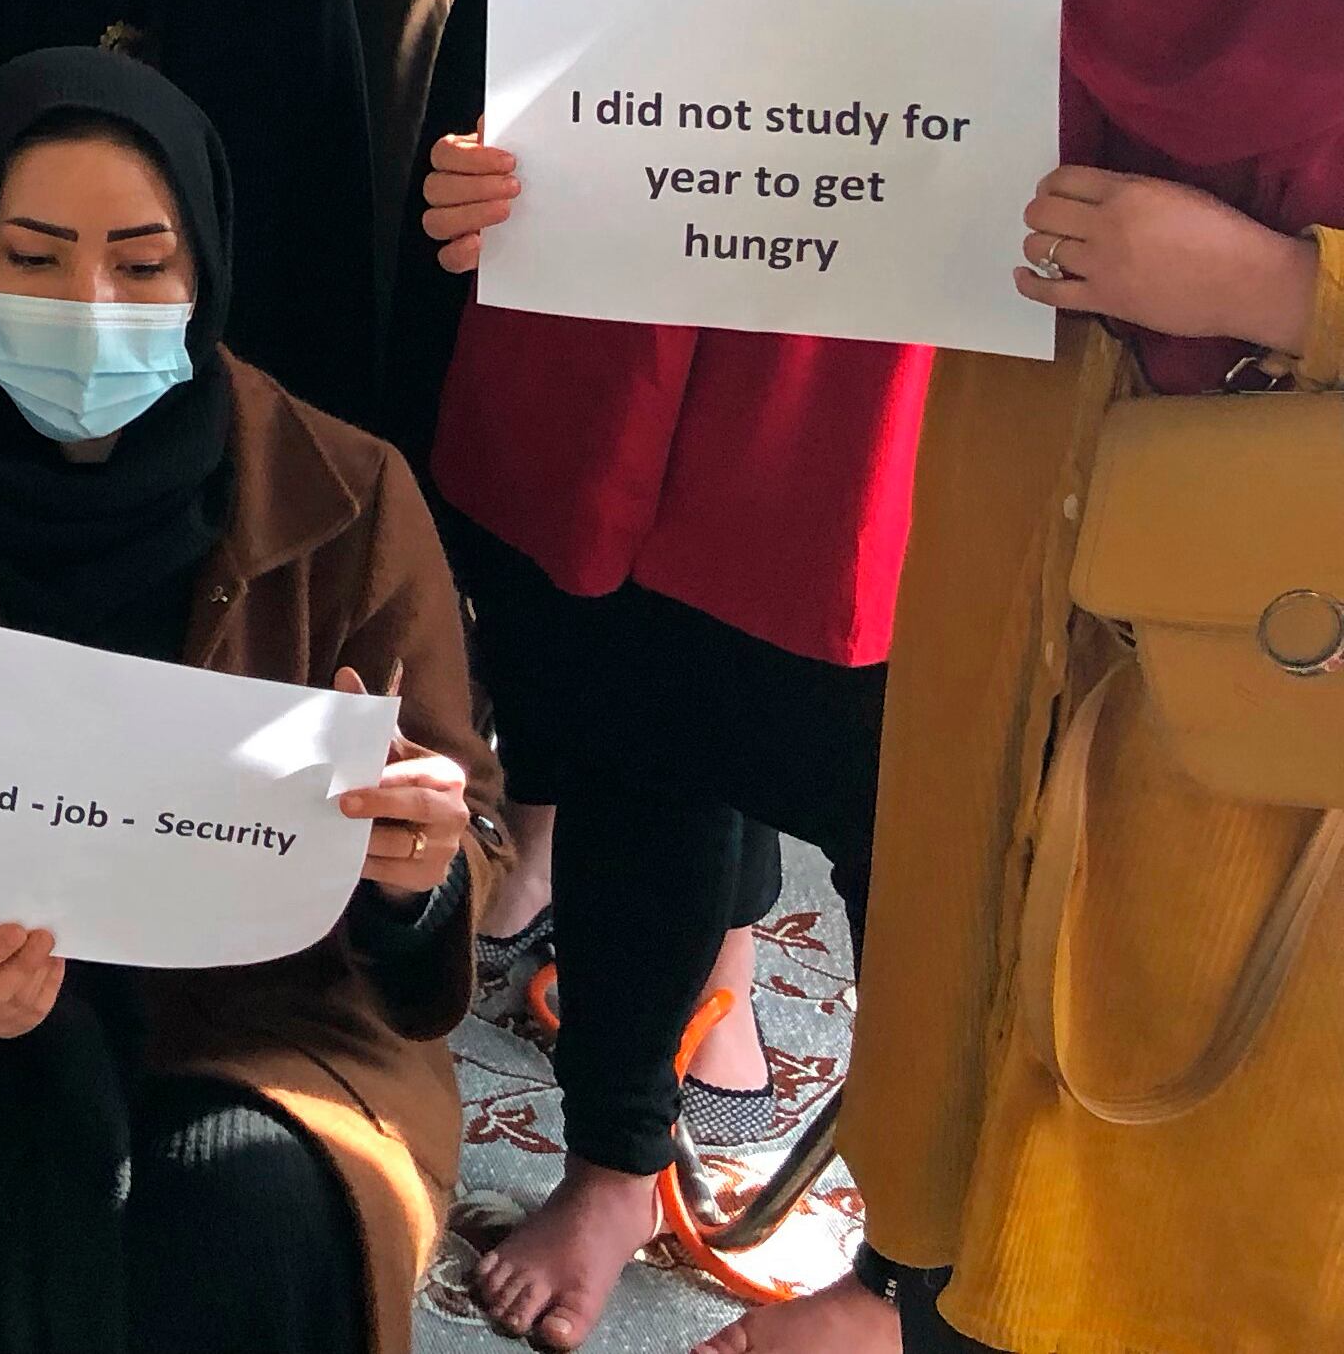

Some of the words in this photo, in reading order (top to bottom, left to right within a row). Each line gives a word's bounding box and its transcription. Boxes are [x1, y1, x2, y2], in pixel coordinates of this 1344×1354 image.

[572, 90, 581, 123] I
[596, 90, 663, 127] did
[679, 100, 752, 132] not
[765, 101, 890, 146] study
[902, 103, 971, 143] for
[644, 166, 742, 200] year
[754, 166, 800, 198] to
[812, 172, 886, 208] get
[684, 223, 840, 272] hungry
[49, 795, 108, 828] job
[154, 812, 297, 856] Security
